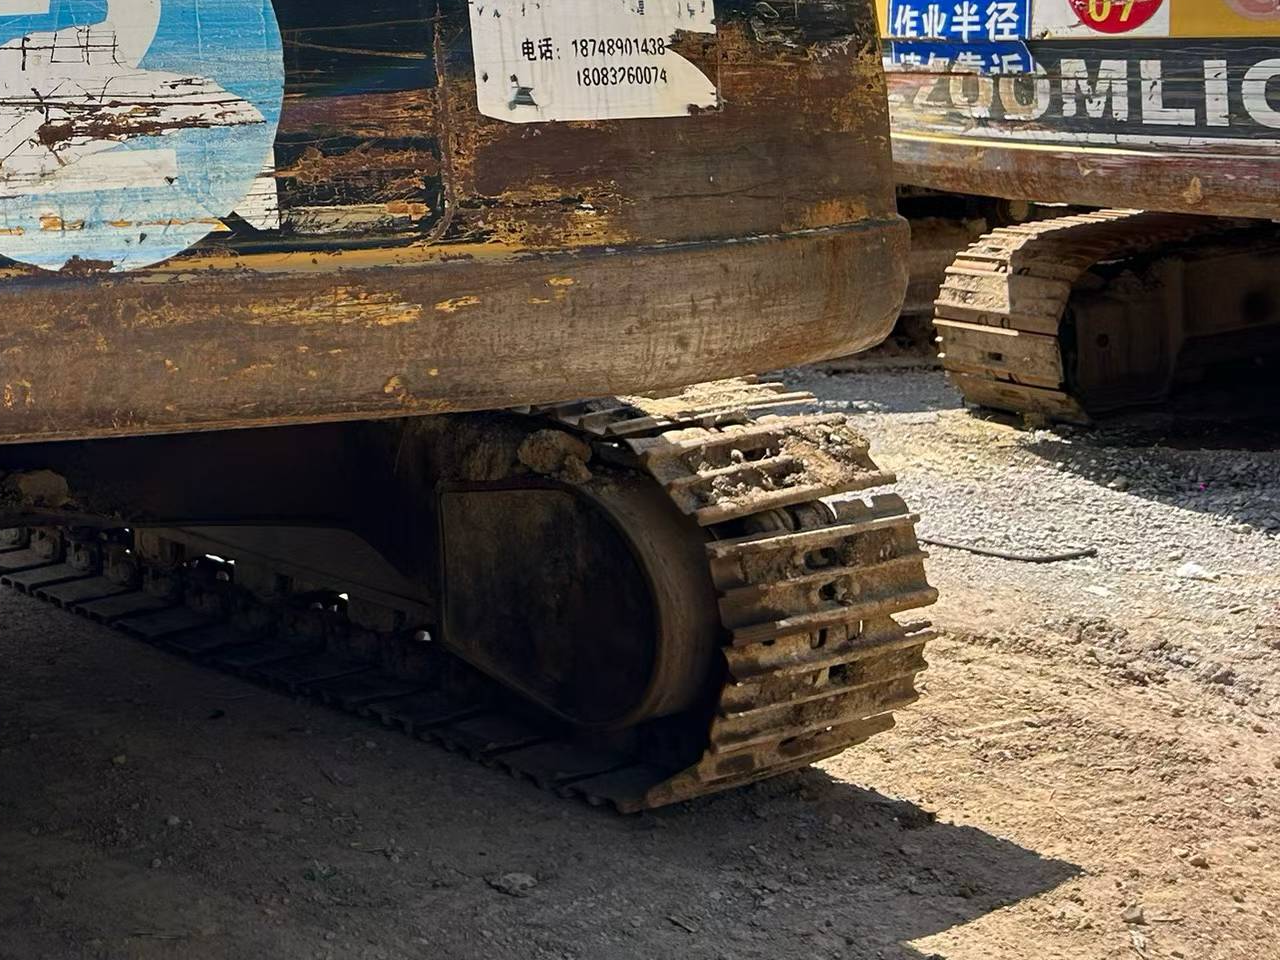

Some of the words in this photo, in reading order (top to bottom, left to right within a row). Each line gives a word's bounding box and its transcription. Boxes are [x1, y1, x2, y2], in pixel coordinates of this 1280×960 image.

[894, 0, 1020, 44] 作业半径
[571, 37, 666, 58] 18748901438
